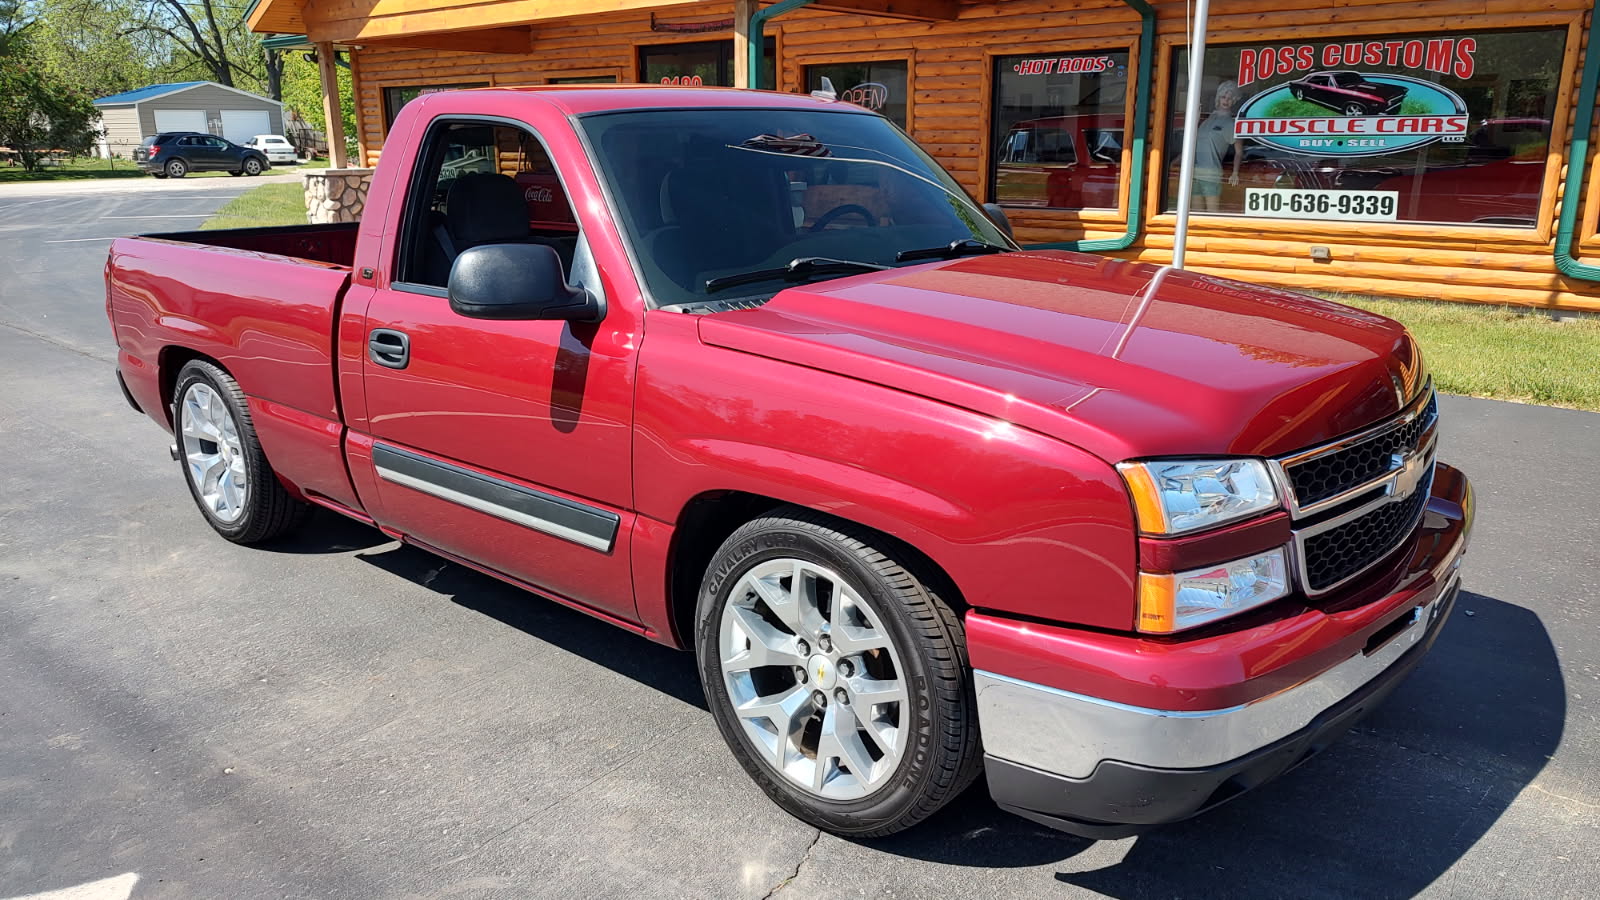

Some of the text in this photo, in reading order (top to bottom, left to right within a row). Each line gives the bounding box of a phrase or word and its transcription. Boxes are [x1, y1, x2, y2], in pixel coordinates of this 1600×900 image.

[1019, 56, 1109, 76] HOT RODS
[1238, 38, 1477, 87] ROSS CUSTOMS
[841, 88, 884, 109] OPEN
[1235, 117, 1466, 134] MUSCLE CARS
[1299, 139, 1387, 147] BUY SELL
[1248, 192, 1395, 216] 810-636-9339
[709, 538, 758, 596] CAVALRY
[902, 675, 930, 793] ROADONE
